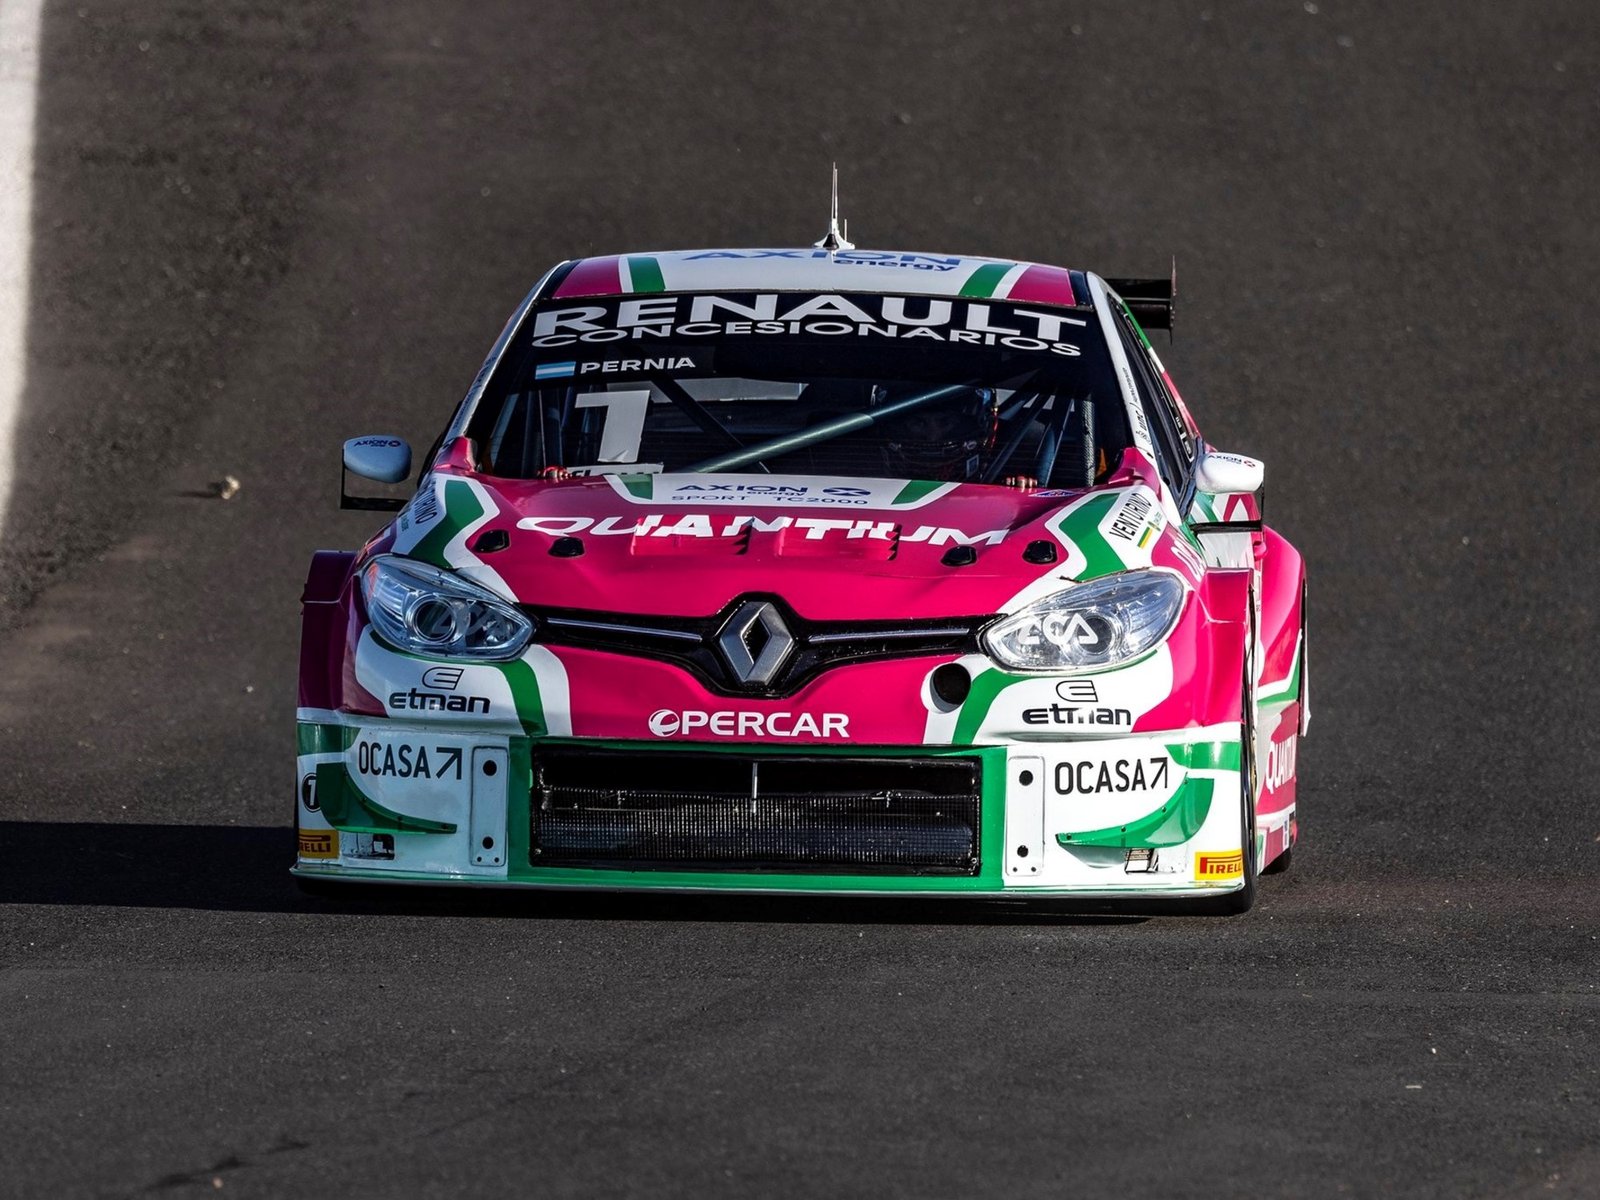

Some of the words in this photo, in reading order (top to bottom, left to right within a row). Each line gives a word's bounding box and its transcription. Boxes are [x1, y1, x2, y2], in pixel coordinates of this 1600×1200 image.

[682, 251, 961, 266] AXION
[833, 259, 956, 272] energy
[533, 294, 1086, 341] RENAULT
[532, 321, 1081, 357] CONCESIONARIOS
[580, 356, 696, 374] PERNIA
[575, 389, 650, 463] 1
[675, 484, 808, 493] AXION
[747, 489, 806, 497] energy
[773, 495, 868, 505] TC2000
[1109, 493, 1152, 540] VENTURINO
[389, 688, 491, 714] etman
[358, 741, 431, 779] OCASA
[1054, 758, 1147, 795] OCASA
[1200, 855, 1242, 874] PIRELL
